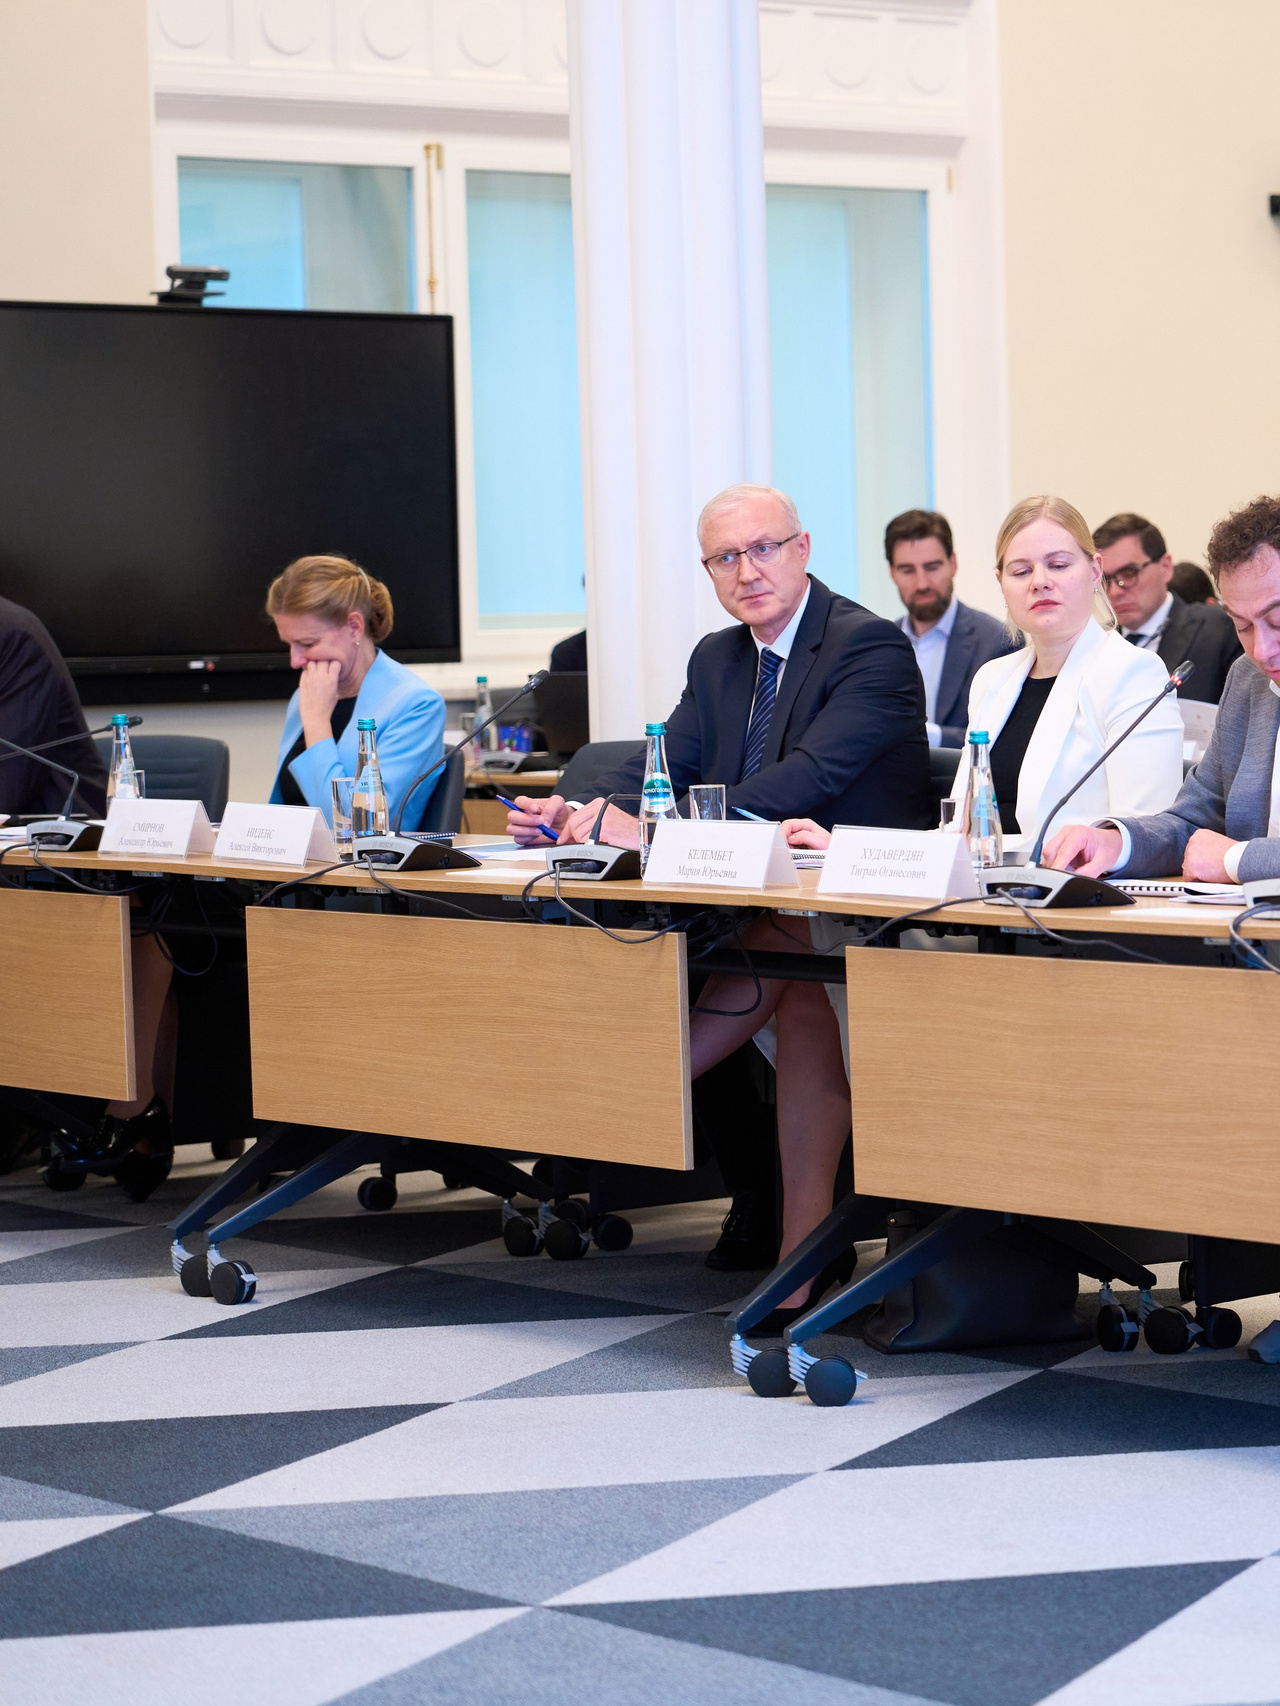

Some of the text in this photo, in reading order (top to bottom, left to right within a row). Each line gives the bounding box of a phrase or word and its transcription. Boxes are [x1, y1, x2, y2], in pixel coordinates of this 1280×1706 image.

[133, 822, 165, 833] СМИРНОВ
[146, 837, 174, 849] Юрьевич
[228, 841, 287, 856] Алексей Викторович
[687, 849, 735, 862] КЕЛЕМБЕТ
[860, 848, 925, 862] ХУДАВЕРДЯН
[677, 865, 738, 880] Мария Юрьевна
[850, 864, 927, 880] Тигран Оганесович
[1015, 873, 1037, 881] BOSCH
